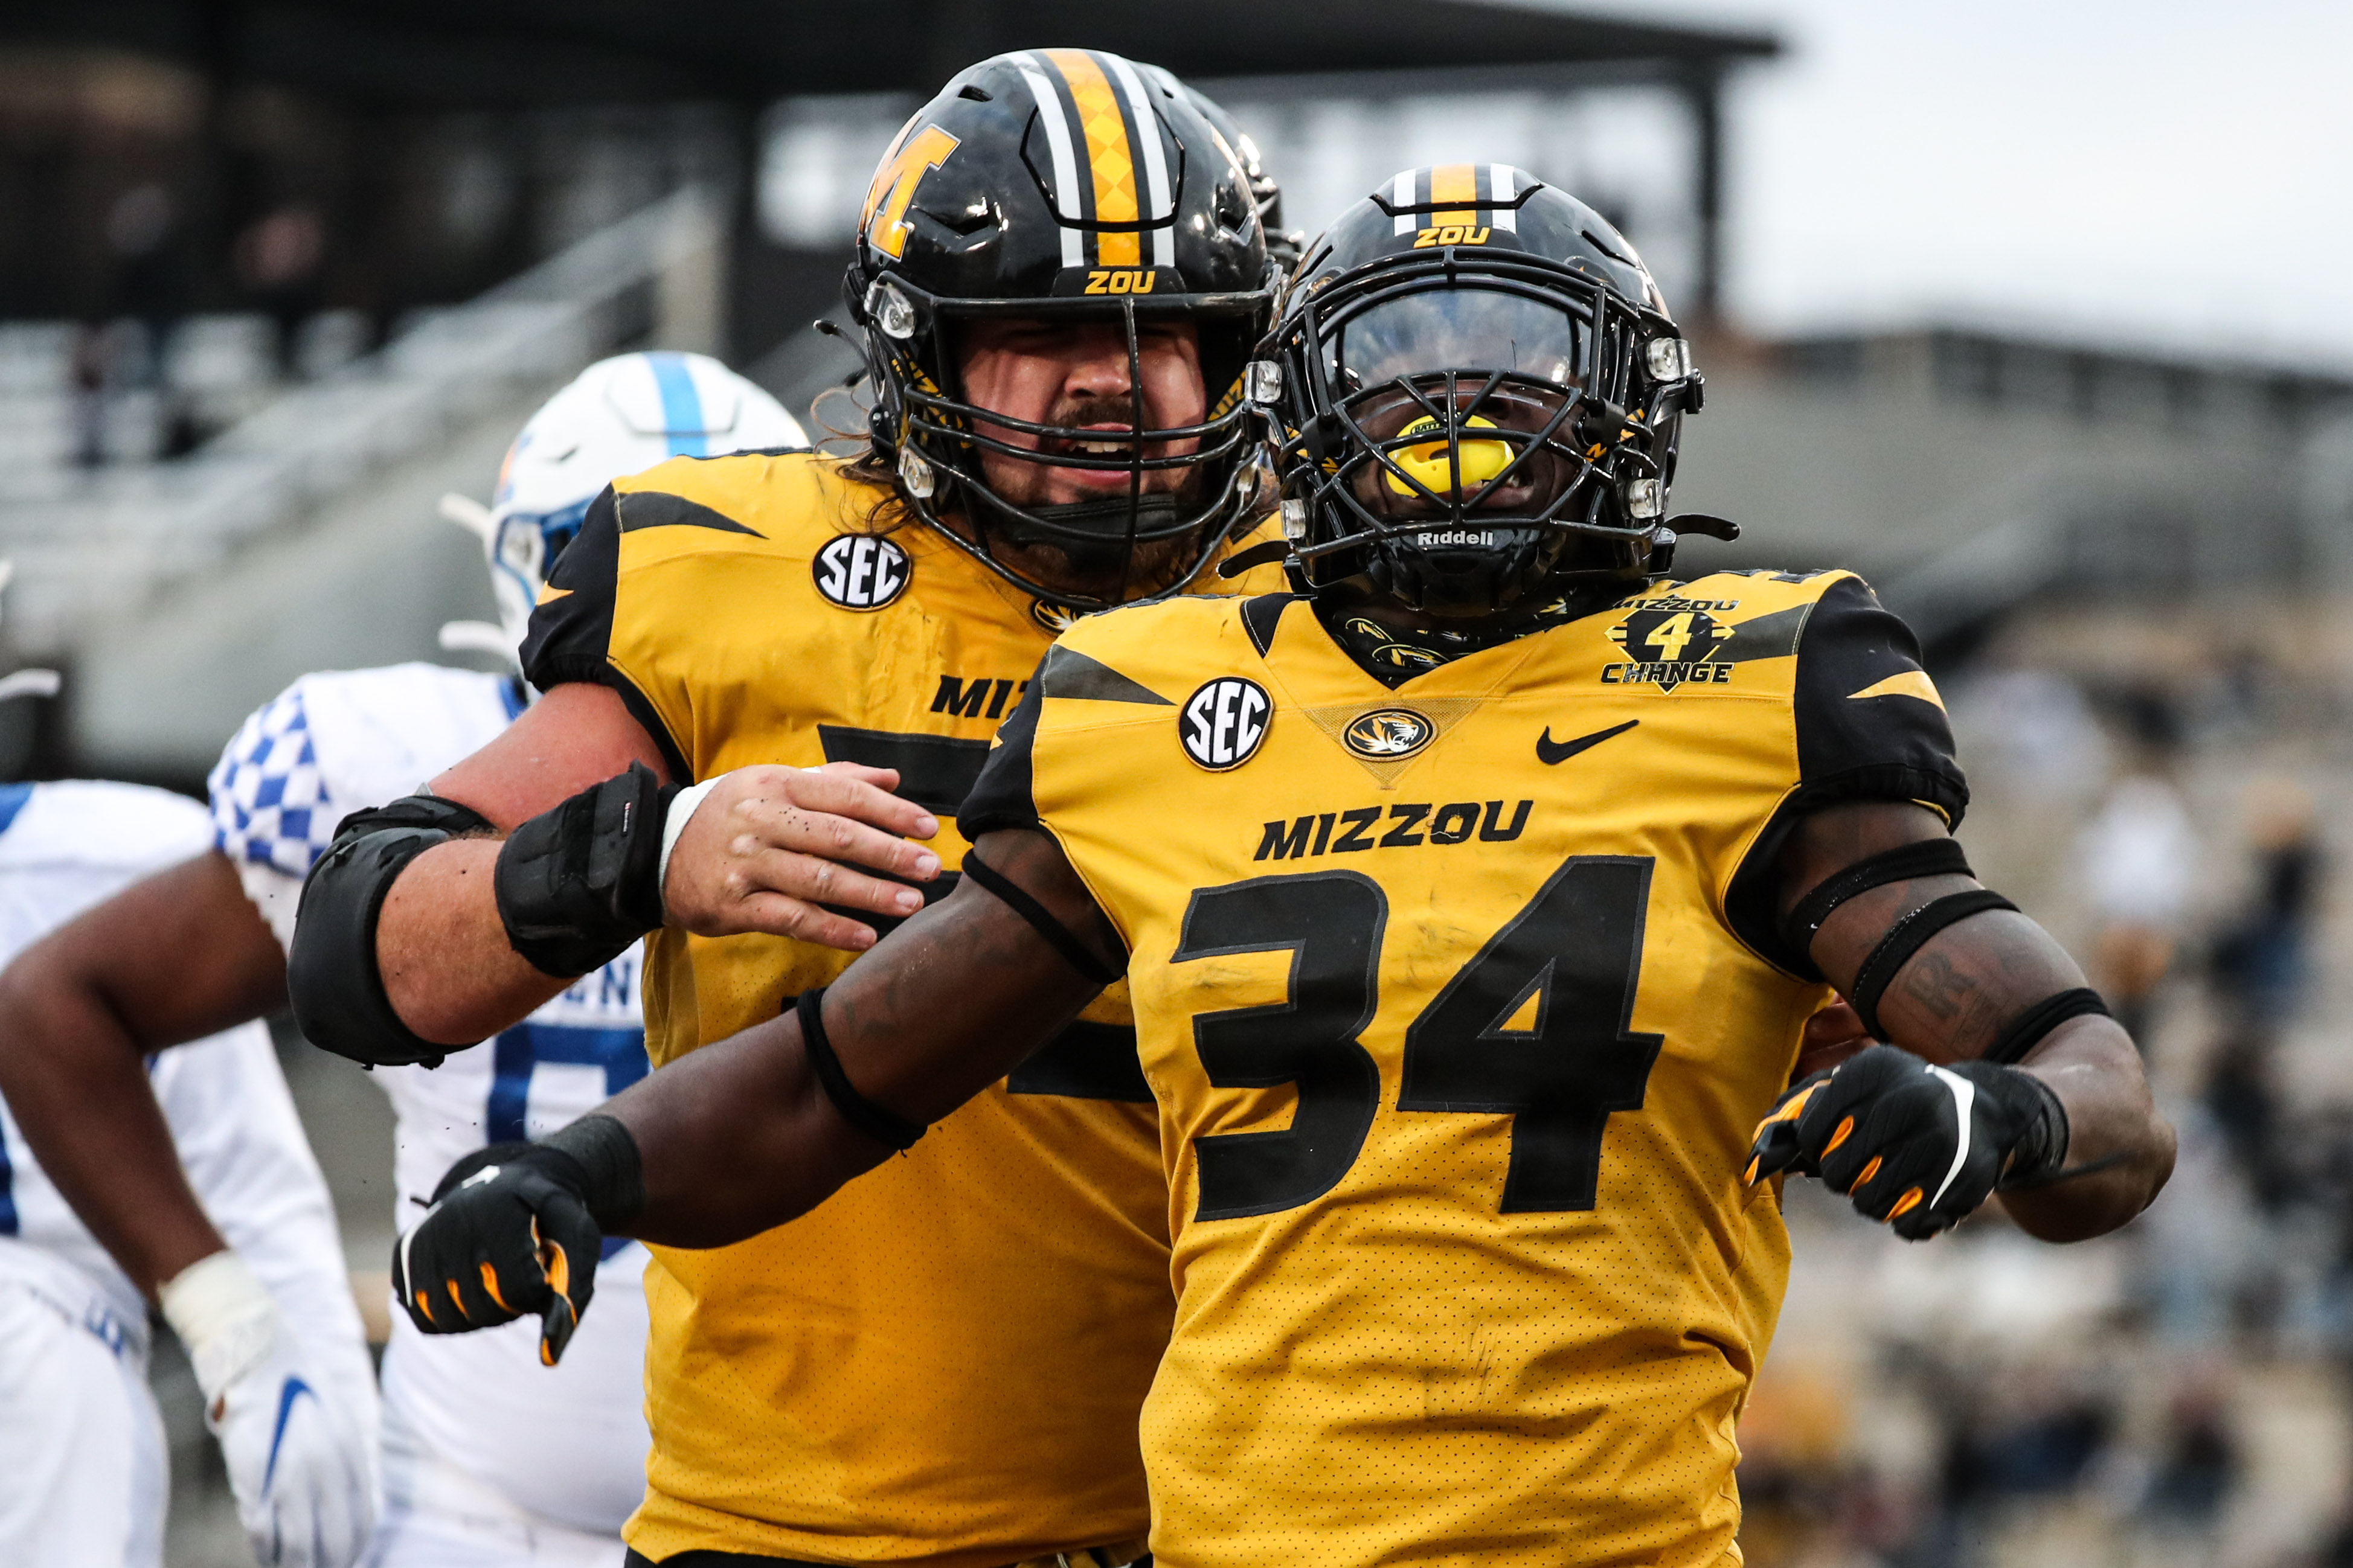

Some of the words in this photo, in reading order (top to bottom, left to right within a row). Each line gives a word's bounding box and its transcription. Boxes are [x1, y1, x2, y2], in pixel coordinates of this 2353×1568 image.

[1413, 226, 1490, 249] ZOU
[1084, 270, 1156, 295] ZOU
[1417, 531, 1493, 546] Riddell
[820, 536, 904, 605] SEC
[1644, 612, 1695, 661] 4
[1600, 662, 1735, 685] CHANGE
[1186, 681, 1266, 764] SEC
[1253, 799, 1534, 862] MIZZOU
[1169, 855, 1665, 1223] 34
